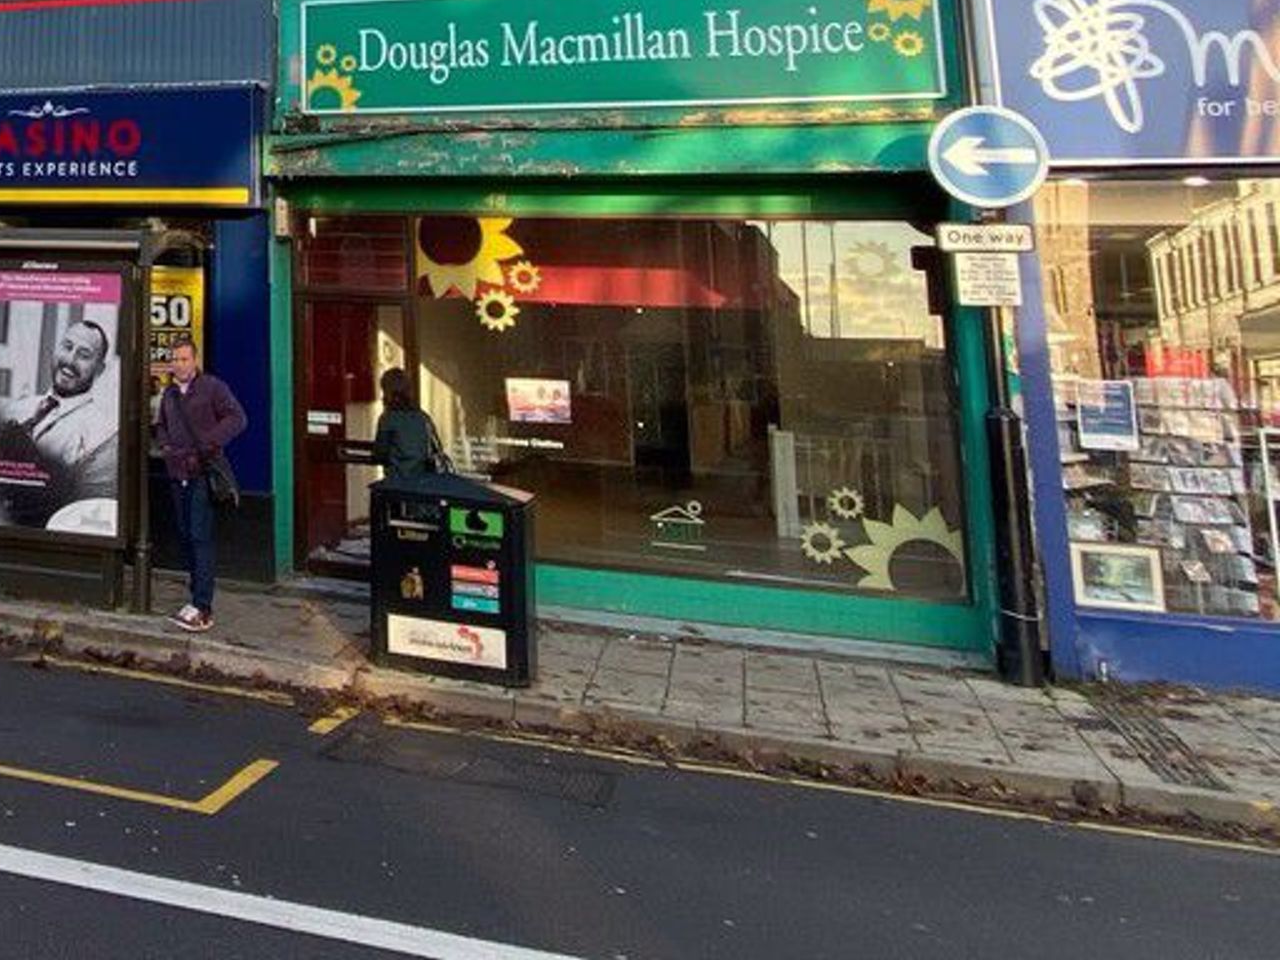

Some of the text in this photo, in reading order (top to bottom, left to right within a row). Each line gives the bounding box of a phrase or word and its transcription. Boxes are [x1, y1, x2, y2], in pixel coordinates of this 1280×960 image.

[358, 6, 866, 85] Douglas Macmillan Hospice
[1197, 97, 1236, 117] for
[22, 160, 139, 177] EXPERIENCE
[947, 230, 1024, 246] One way
[150, 296, 191, 327] 50
